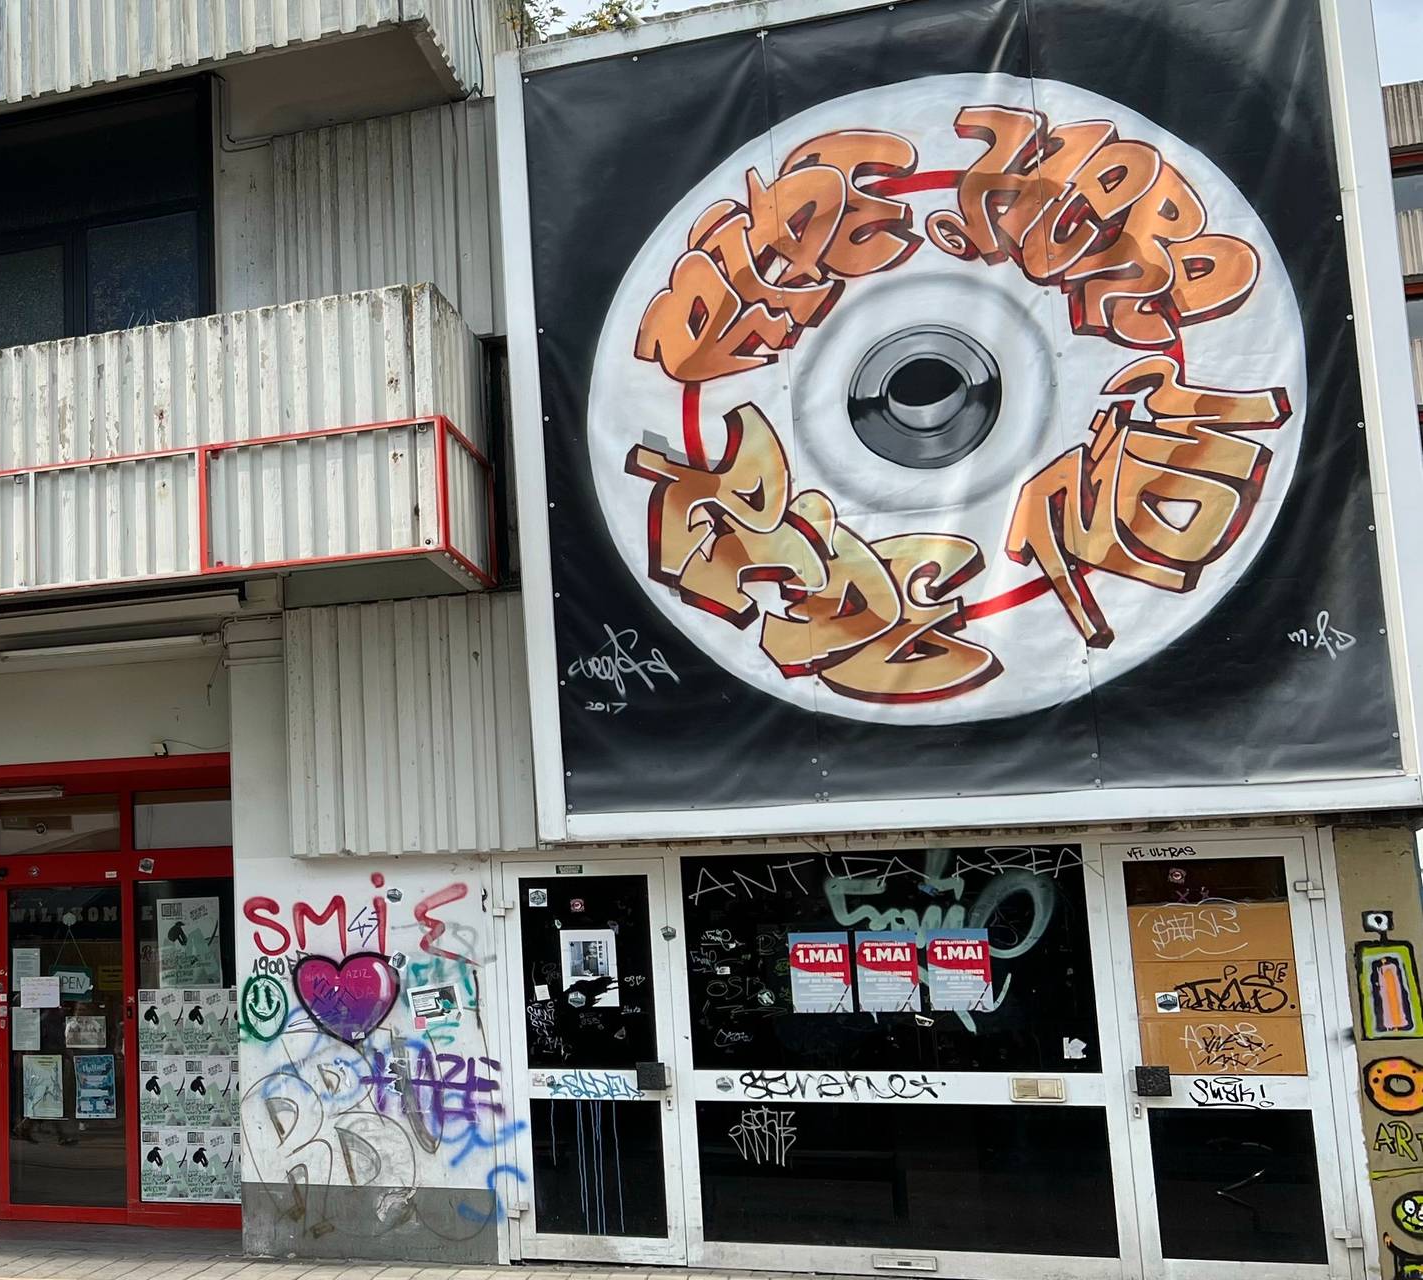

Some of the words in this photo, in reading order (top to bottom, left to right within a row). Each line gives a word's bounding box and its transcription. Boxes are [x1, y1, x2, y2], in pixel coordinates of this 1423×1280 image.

[585, 701, 628, 714] 2017
[796, 949, 844, 963] 1.MAI
[862, 947, 911, 962] 1.MAI
[933, 945, 984, 960] 1.MAI
[59, 975, 86, 989] PEN
